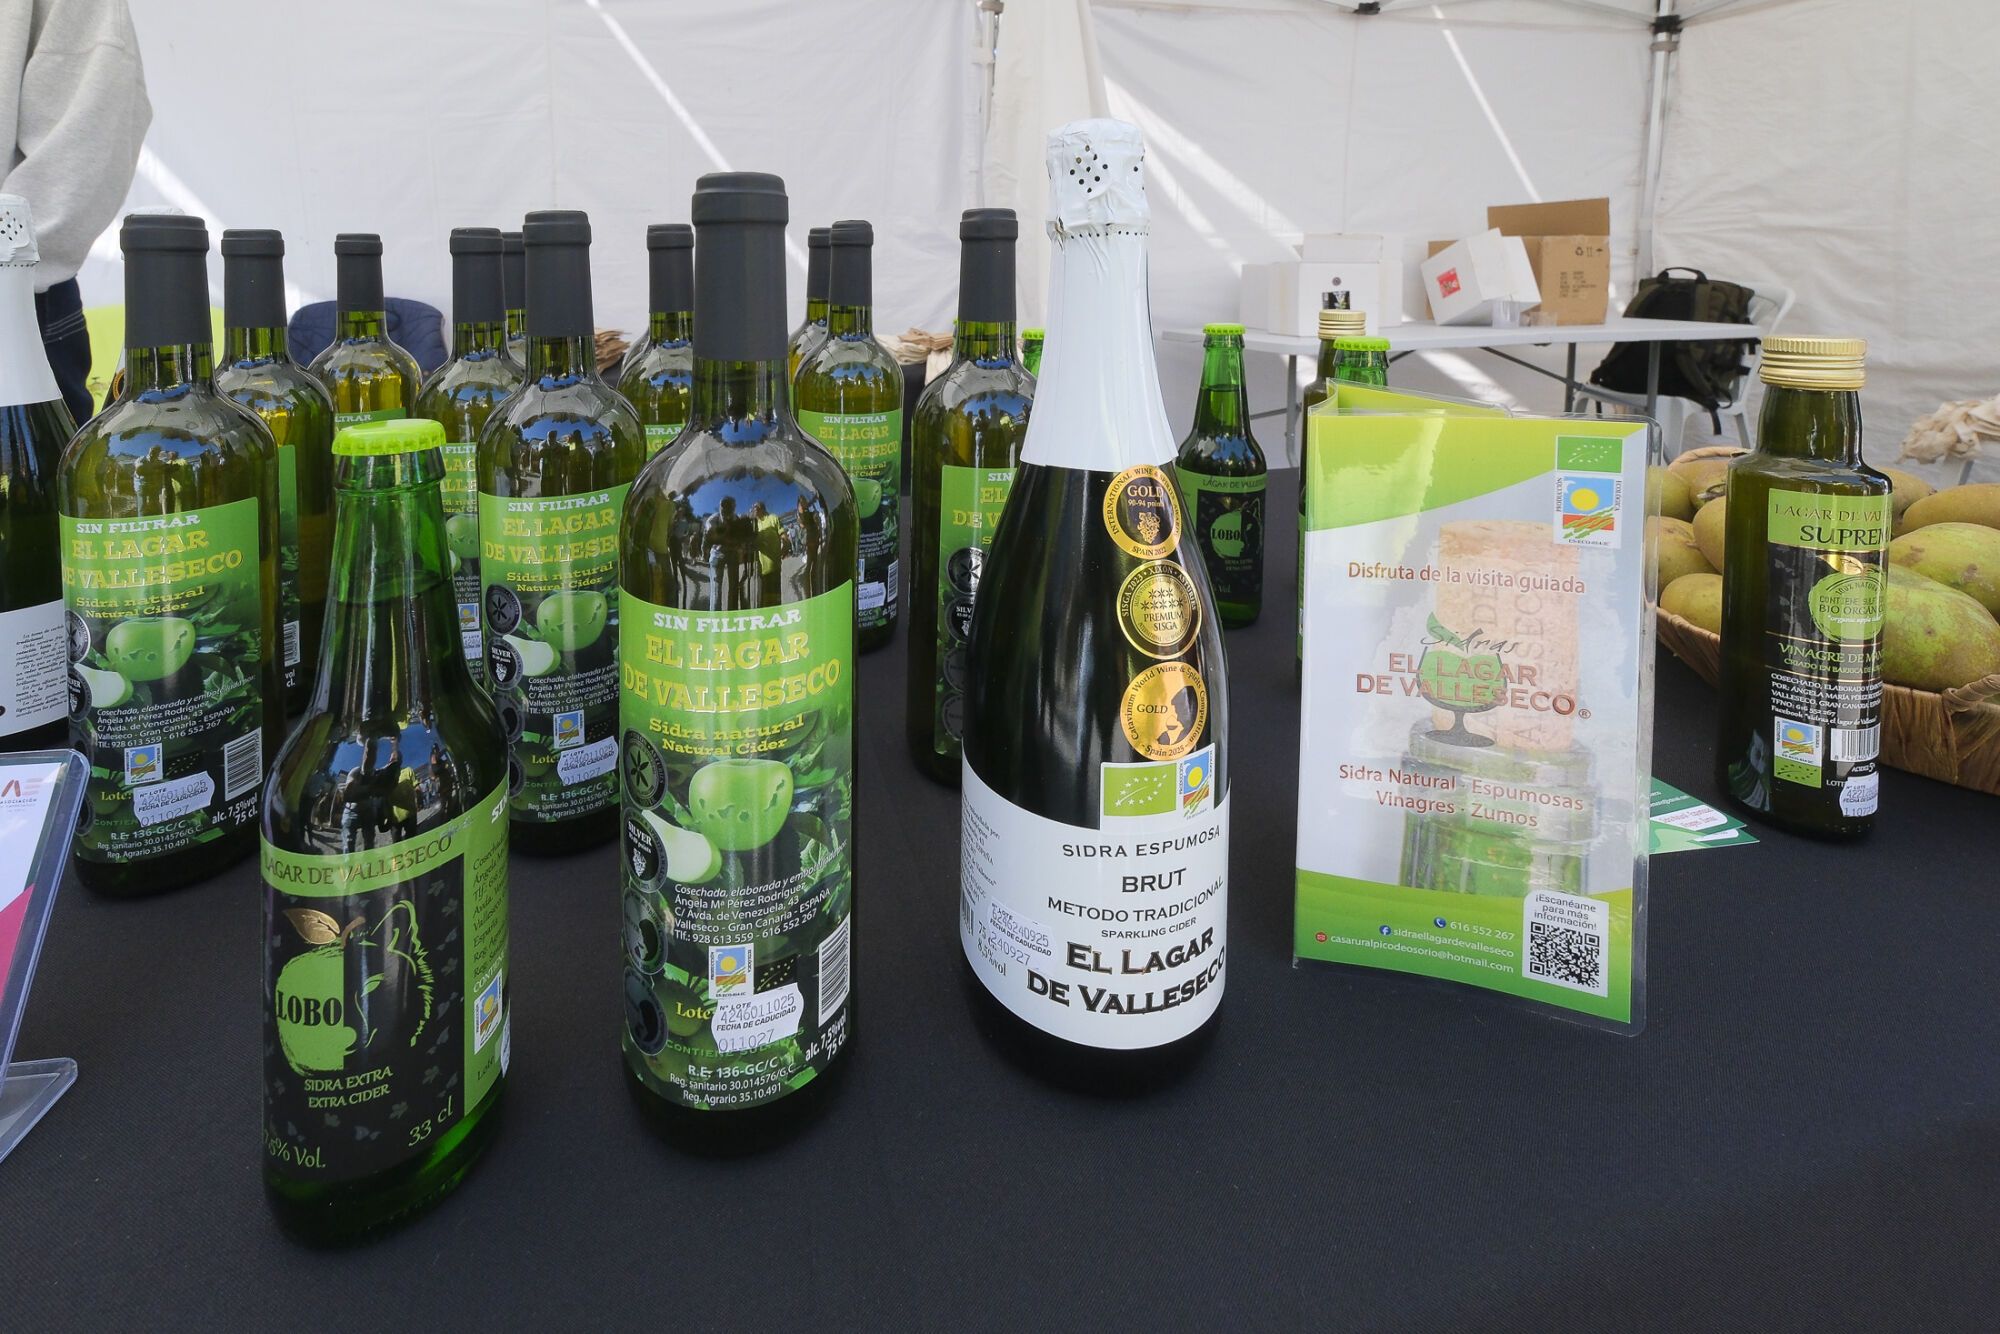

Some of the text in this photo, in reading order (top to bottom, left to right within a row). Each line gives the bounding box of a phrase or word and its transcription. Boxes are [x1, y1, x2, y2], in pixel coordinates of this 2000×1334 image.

[844, 415, 887, 424] FILTRAR
[819, 426, 889, 440] EL LAGAR
[1127, 485, 1164, 497] GOLD
[508, 494, 610, 512] SIN FILTRAR
[1107, 473, 1132, 535] INTERNATIONAL
[1775, 504, 1831, 520] LAGAR
[77, 515, 200, 533] SIN FILTRAR
[503, 509, 616, 536] EL LAGAR
[953, 510, 982, 528] DE
[72, 530, 209, 560] EL LAGAR
[1212, 528, 1240, 540] LOBO
[485, 542, 505, 561] DE
[1132, 546, 1154, 556] SPAIN
[79, 550, 243, 588] VALLESECO
[507, 562, 614, 581] Sidra natural
[1348, 562, 1585, 594] Disfruta de la visita guiada
[517, 576, 603, 592] Natural Cider
[77, 586, 205, 608] Sidra natural
[1122, 574, 1143, 617] SISGA 2023
[86, 601, 189, 619] Natural Cider
[1144, 611, 1184, 622] PREMIUM
[1819, 605, 1840, 614] BIO
[654, 609, 801, 633] SIN FILTRAR
[1154, 622, 1177, 631] SISGA
[646, 632, 810, 670] EL LAGAR
[1421, 628, 1519, 654] Sidras
[1779, 643, 1864, 663] VINAGRE DE
[1784, 658, 1818, 670] CRIADO
[1389, 653, 1537, 687] EL LAGAR
[624, 658, 840, 712] DE VALLESECO
[1771, 673, 1865, 692] COSECHADO, ELABORADO
[1772, 681, 1789, 690] POR:
[1132, 666, 1205, 742] World Wine Spirits Competition
[1356, 674, 1576, 716] DE VALLESECO
[1771, 690, 1841, 709] VALLESECO, GRAN
[1771, 698, 1794, 709] TFNO:
[1137, 704, 1168, 713] GOLD
[1771, 705, 1803, 718] Facebook
[98, 732, 133, 740] Valleseco
[112, 720, 221, 748] 928 613 616 552 267
[649, 713, 804, 741] Sidra natural
[663, 737, 788, 755] Natural Cider
[1145, 745, 1184, 756] Spain 2025
[1339, 764, 1584, 811] Sidra Natural Espumosas
[1377, 790, 1538, 827] Vinagres Zumos
[134, 821, 185, 839] 136-GC/C
[627, 821, 652, 846] SILVER
[1062, 824, 1220, 858] SIDRA ESPUMOSA
[308, 834, 452, 886] DE VALLESECO
[675, 880, 782, 897] Cosechada, elaborada
[1122, 868, 1186, 893] BRUT
[675, 882, 807, 910] Ángela Pérez Rodríguez
[1048, 876, 1224, 922] METODO TRADICIONAL
[1535, 893, 1596, 913] ¡Escanéame
[675, 896, 799, 921] C/ Avda. de Venezuela, 43
[675, 888, 830, 932] Valleseco Gran Canaria ESPAÑA
[1542, 903, 1589, 920] para más
[693, 908, 817, 944] 928 613 559 616 552 267
[1101, 917, 1196, 939] SPARKLING CIDER
[1450, 920, 1515, 941] 616 552 267
[1534, 910, 1598, 930] información!
[990, 919, 1052, 957] FECHA CADUCIDAD
[1393, 927, 1514, 958] sidraellagardevalleseco
[1330, 933, 1514, 974] casaruralpicodeosorio@hotmail.com
[1026, 969, 1070, 1006] DE
[276, 991, 343, 1027] LOBO
[721, 993, 795, 1023] 4246011025
[754, 1006, 796, 1026] CADUCIDAD
[719, 1029, 774, 1052] 011027
[805, 1042, 820, 1061] alc.
[304, 1065, 394, 1092] SIDRA EXTRA
[717, 1057, 778, 1078] 136-GC/C
[670, 1073, 727, 1090] Reg. sanitario
[308, 1083, 390, 1109] EXTRA CIDER
[683, 1082, 781, 1106] Reg. Agrario 35.10.491
[408, 1094, 453, 1148] 33 cl
[294, 1146, 326, 1169] Vol.
